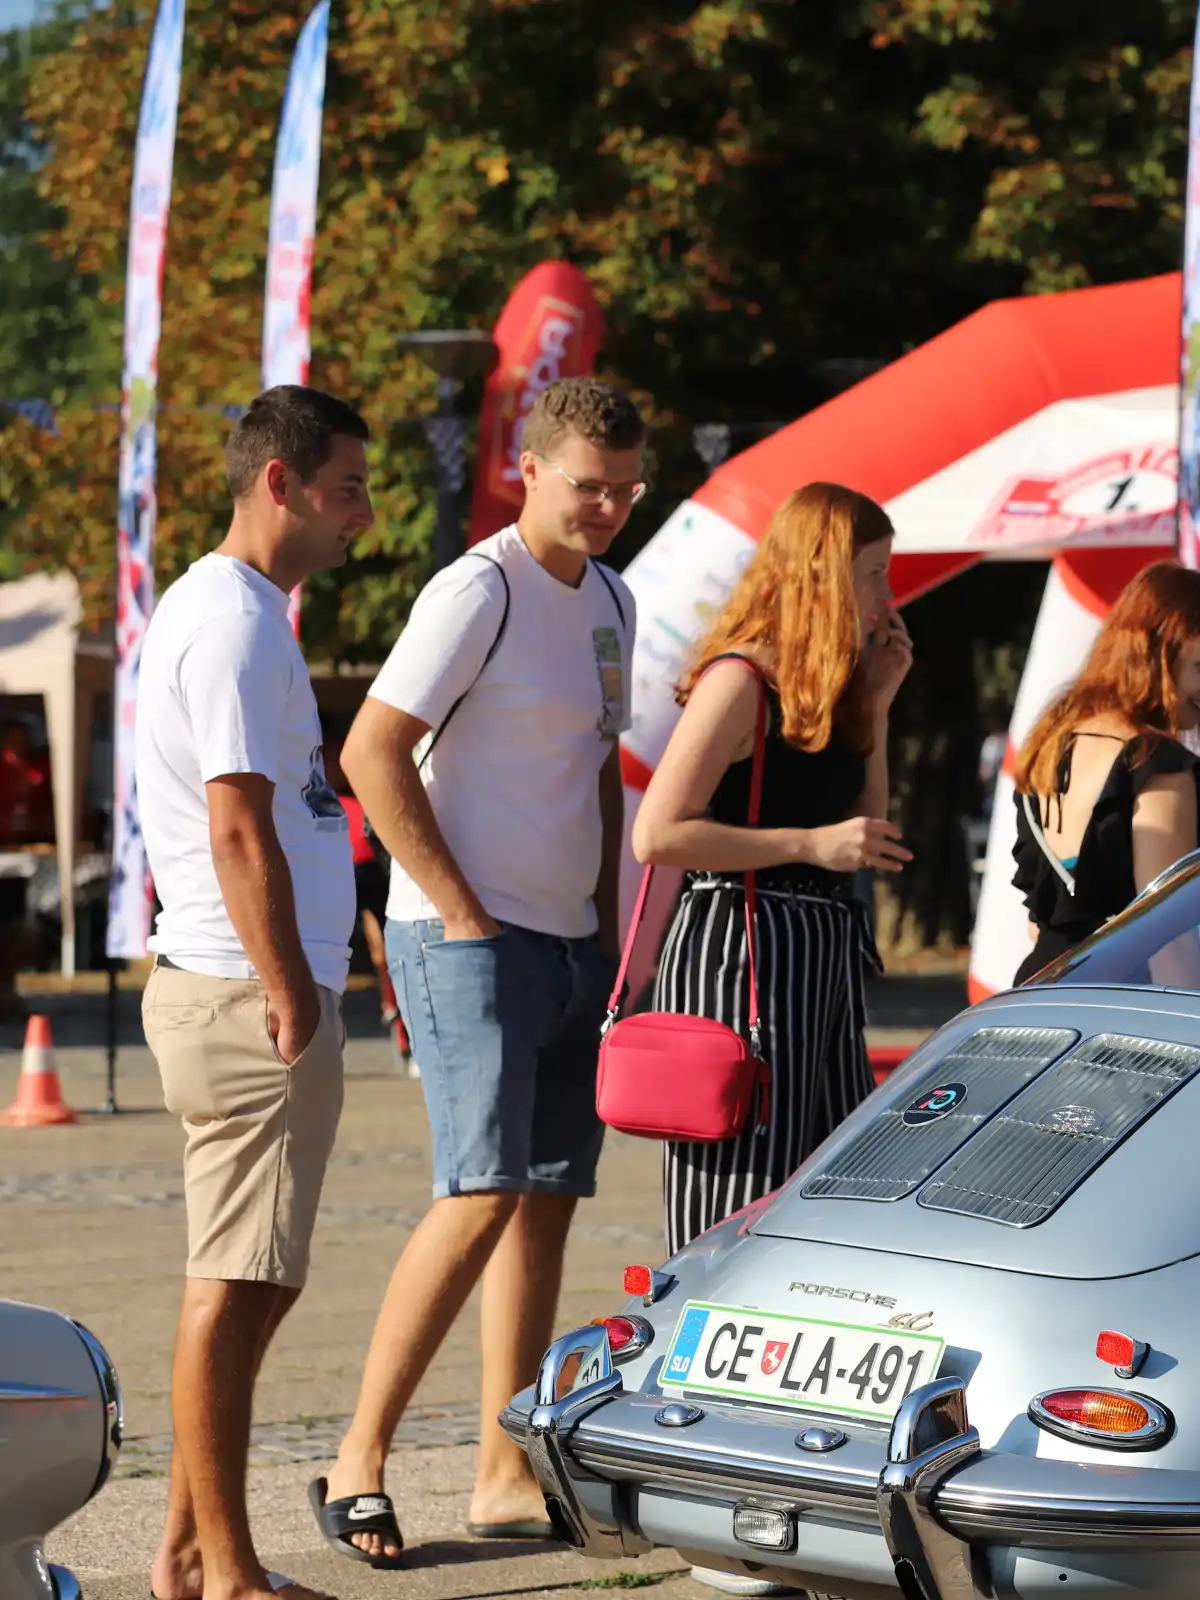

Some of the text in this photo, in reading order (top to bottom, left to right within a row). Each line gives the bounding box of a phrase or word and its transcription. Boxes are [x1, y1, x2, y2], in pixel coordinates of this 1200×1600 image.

[788, 1281, 898, 1309] PORSCHE
[671, 1355, 690, 1372] SLO
[704, 1322, 924, 1404] CE LA-491
[356, 1497, 388, 1511] NIKE
